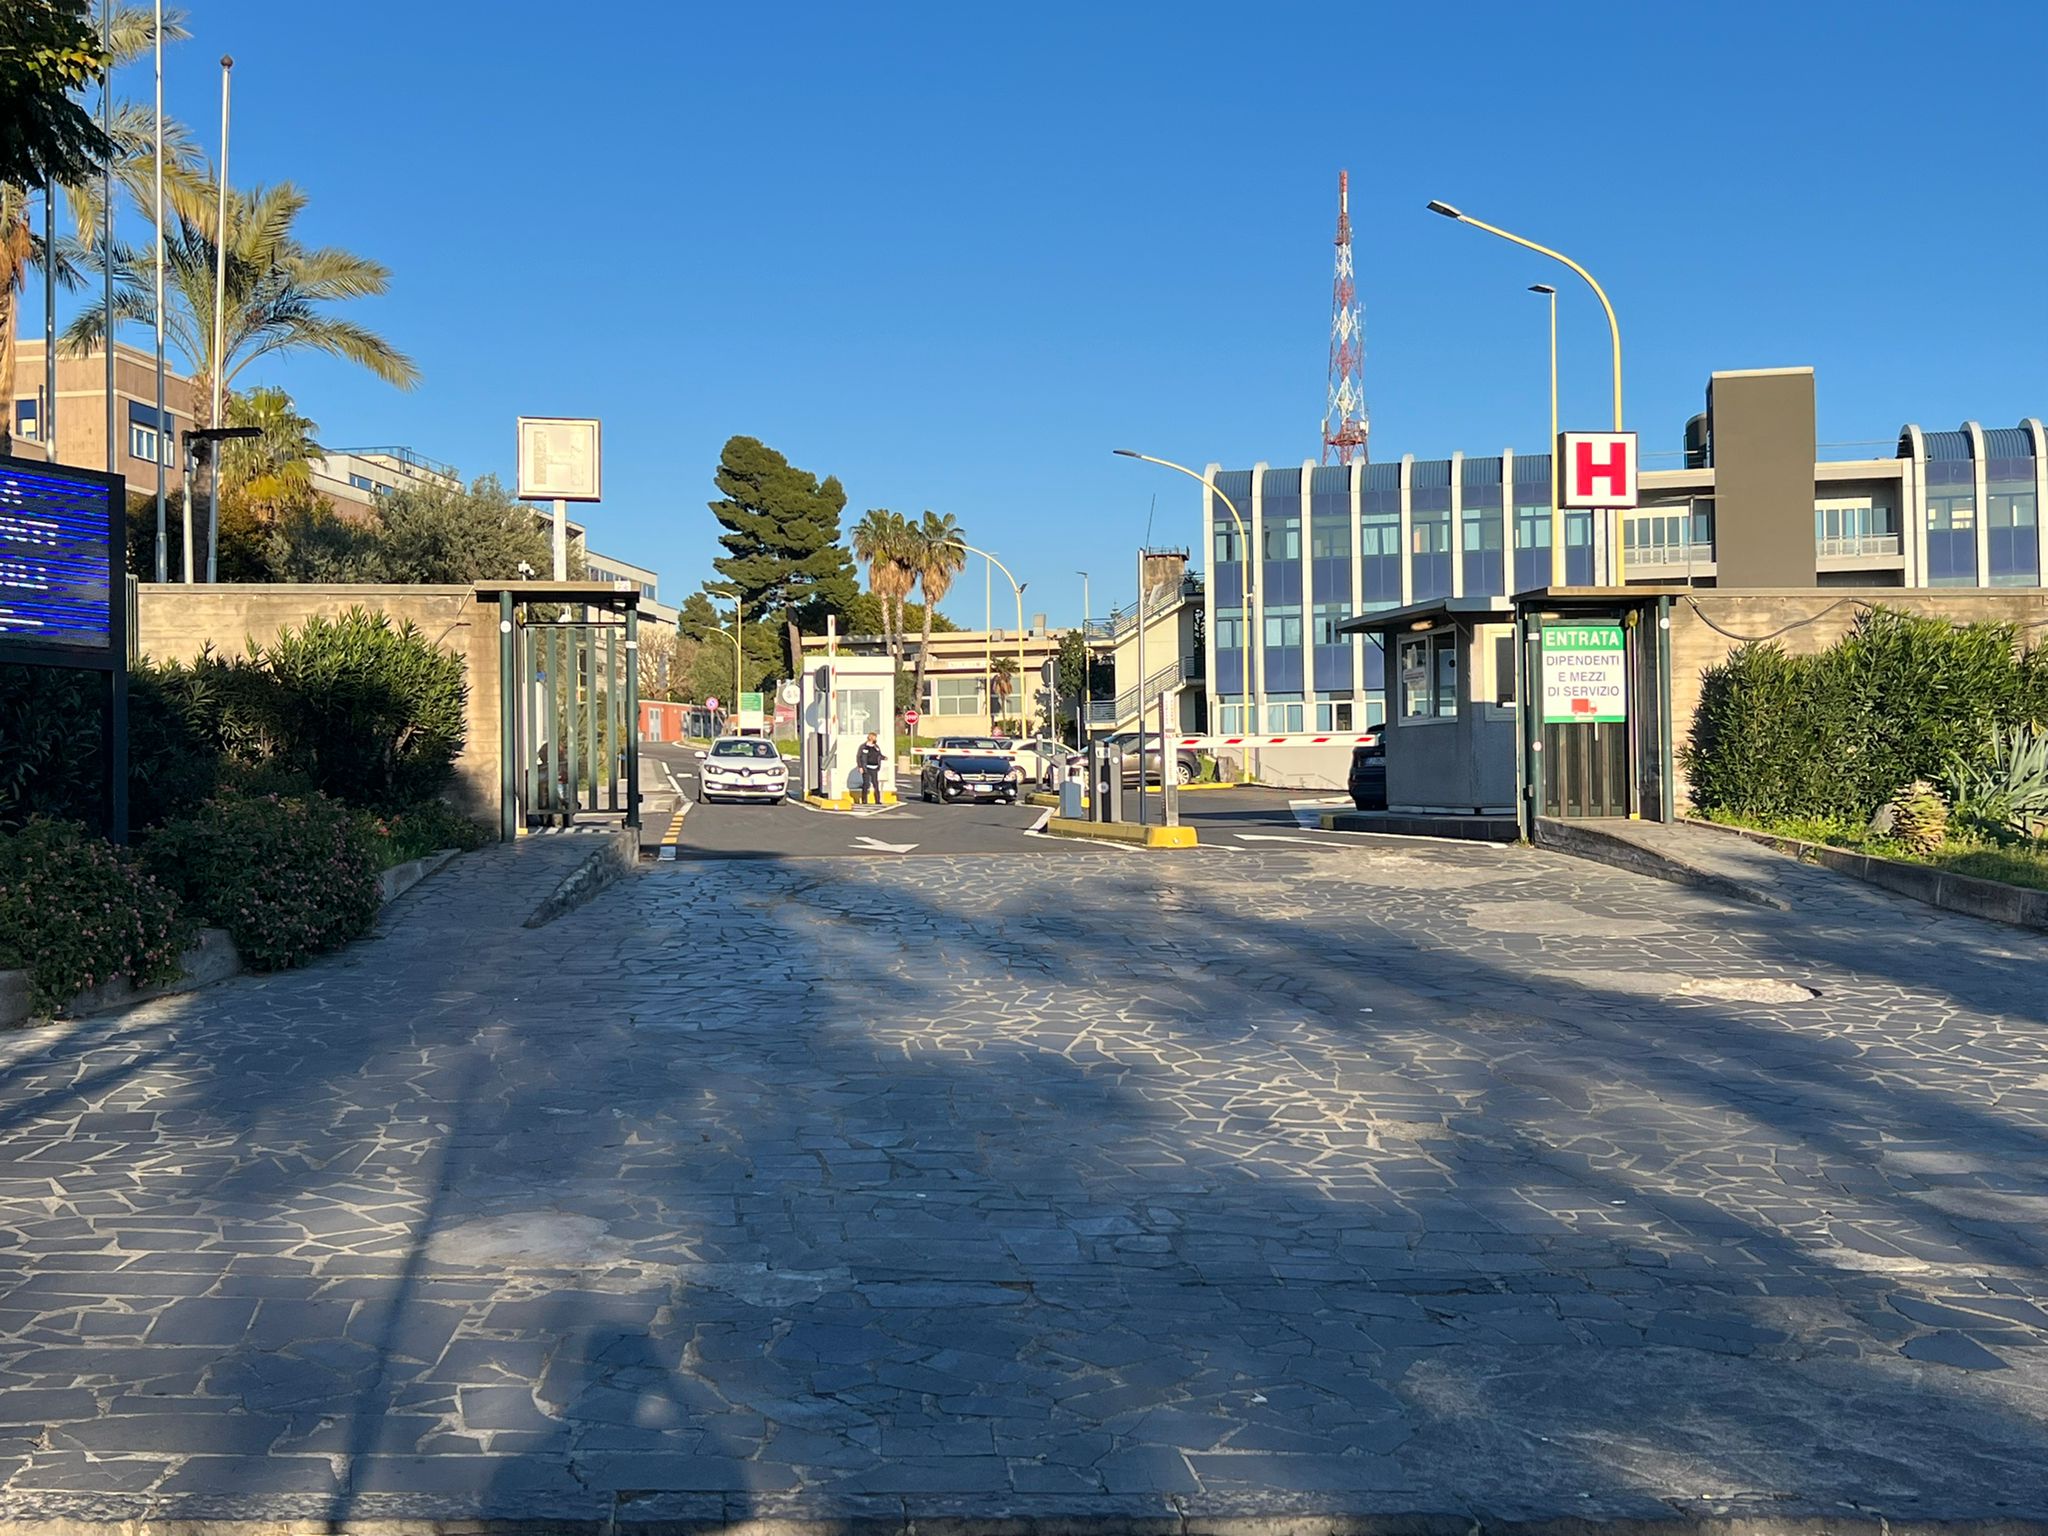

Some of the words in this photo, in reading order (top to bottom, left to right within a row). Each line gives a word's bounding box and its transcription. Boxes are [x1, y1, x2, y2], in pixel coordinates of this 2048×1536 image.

[1576, 442, 1626, 496] H
[1545, 630, 1620, 646] ENTRATA
[1546, 655, 1620, 666] DIPENDENTI
[1558, 672, 1566, 682] E
[1569, 671, 1606, 682] MEZZI
[1547, 686, 1560, 697] DI
[1563, 685, 1620, 697] SERVIZIO
